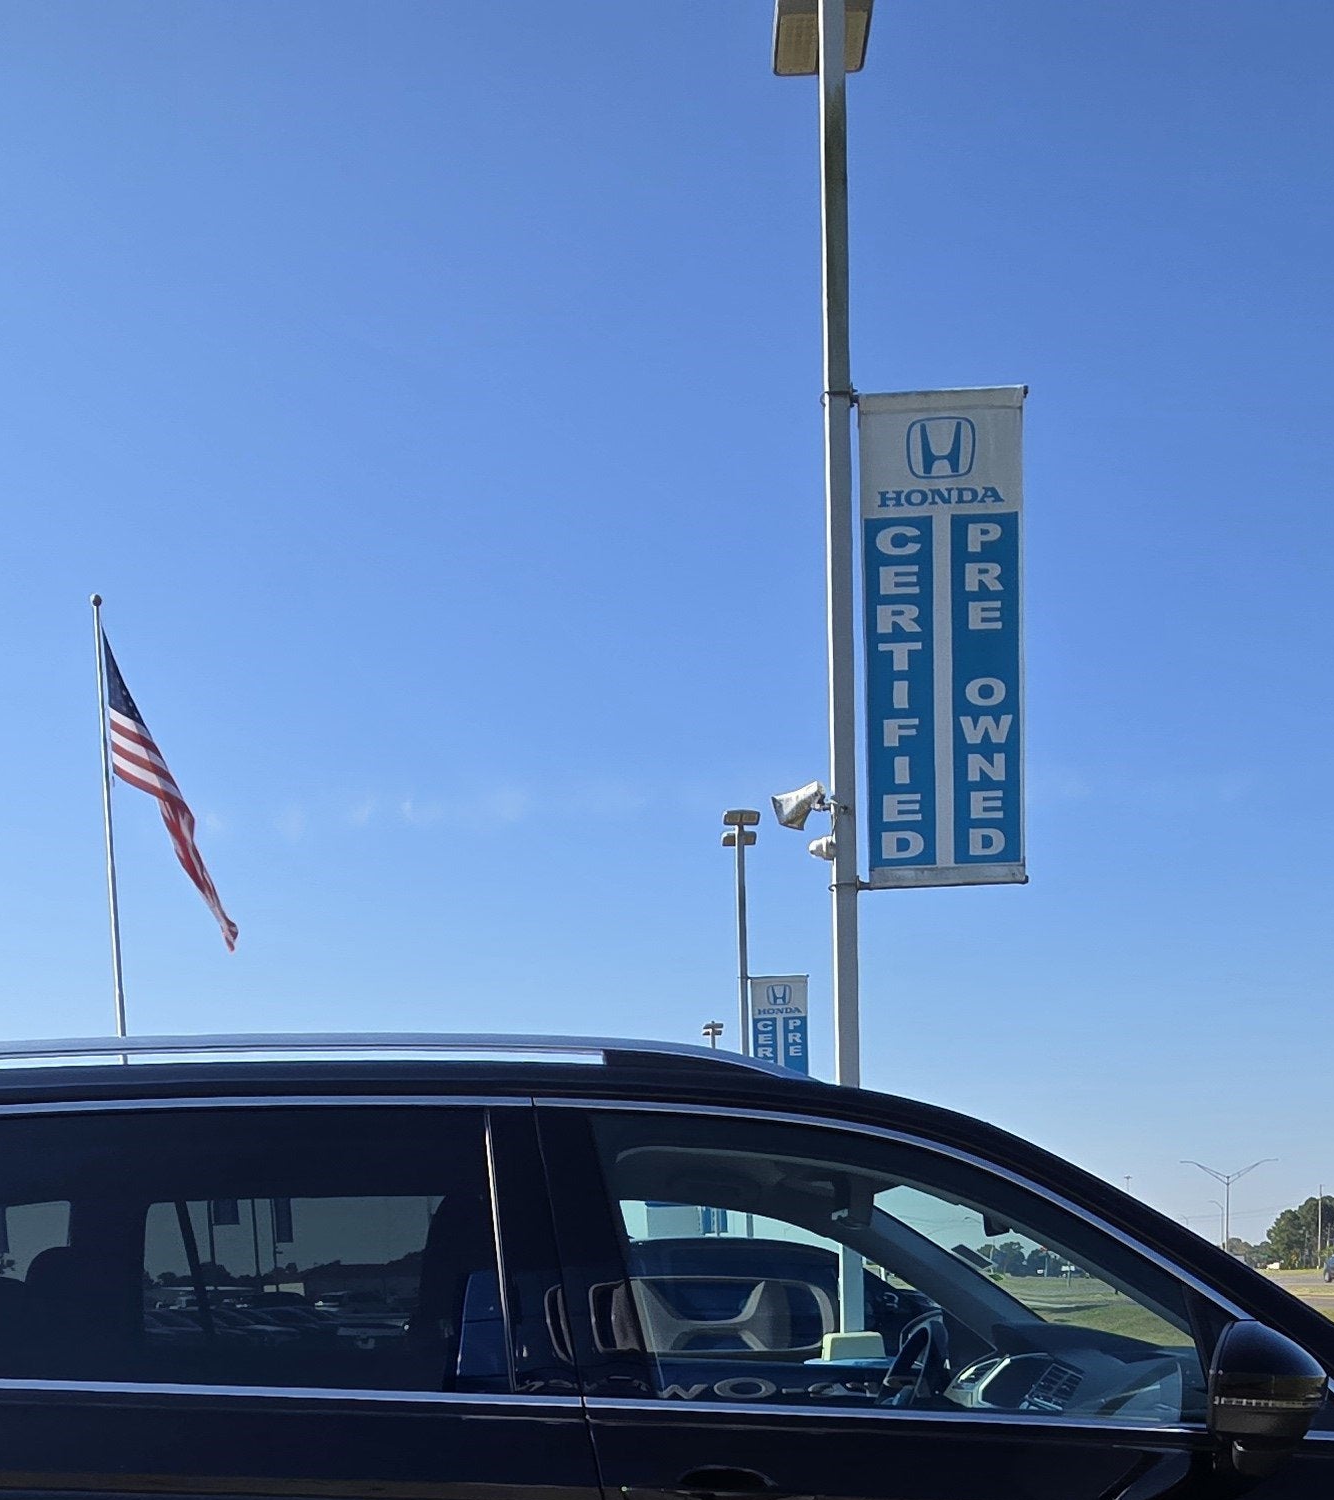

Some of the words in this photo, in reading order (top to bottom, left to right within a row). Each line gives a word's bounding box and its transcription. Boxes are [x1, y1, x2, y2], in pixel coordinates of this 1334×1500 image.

[878, 486, 1005, 508] HONDA
[964, 522, 1004, 631] PRE
[875, 525, 925, 860] CERTIFIED
[960, 677, 1013, 856] OWNED
[757, 1007, 803, 1015] HONDA
[788, 1019, 803, 1057] PRE
